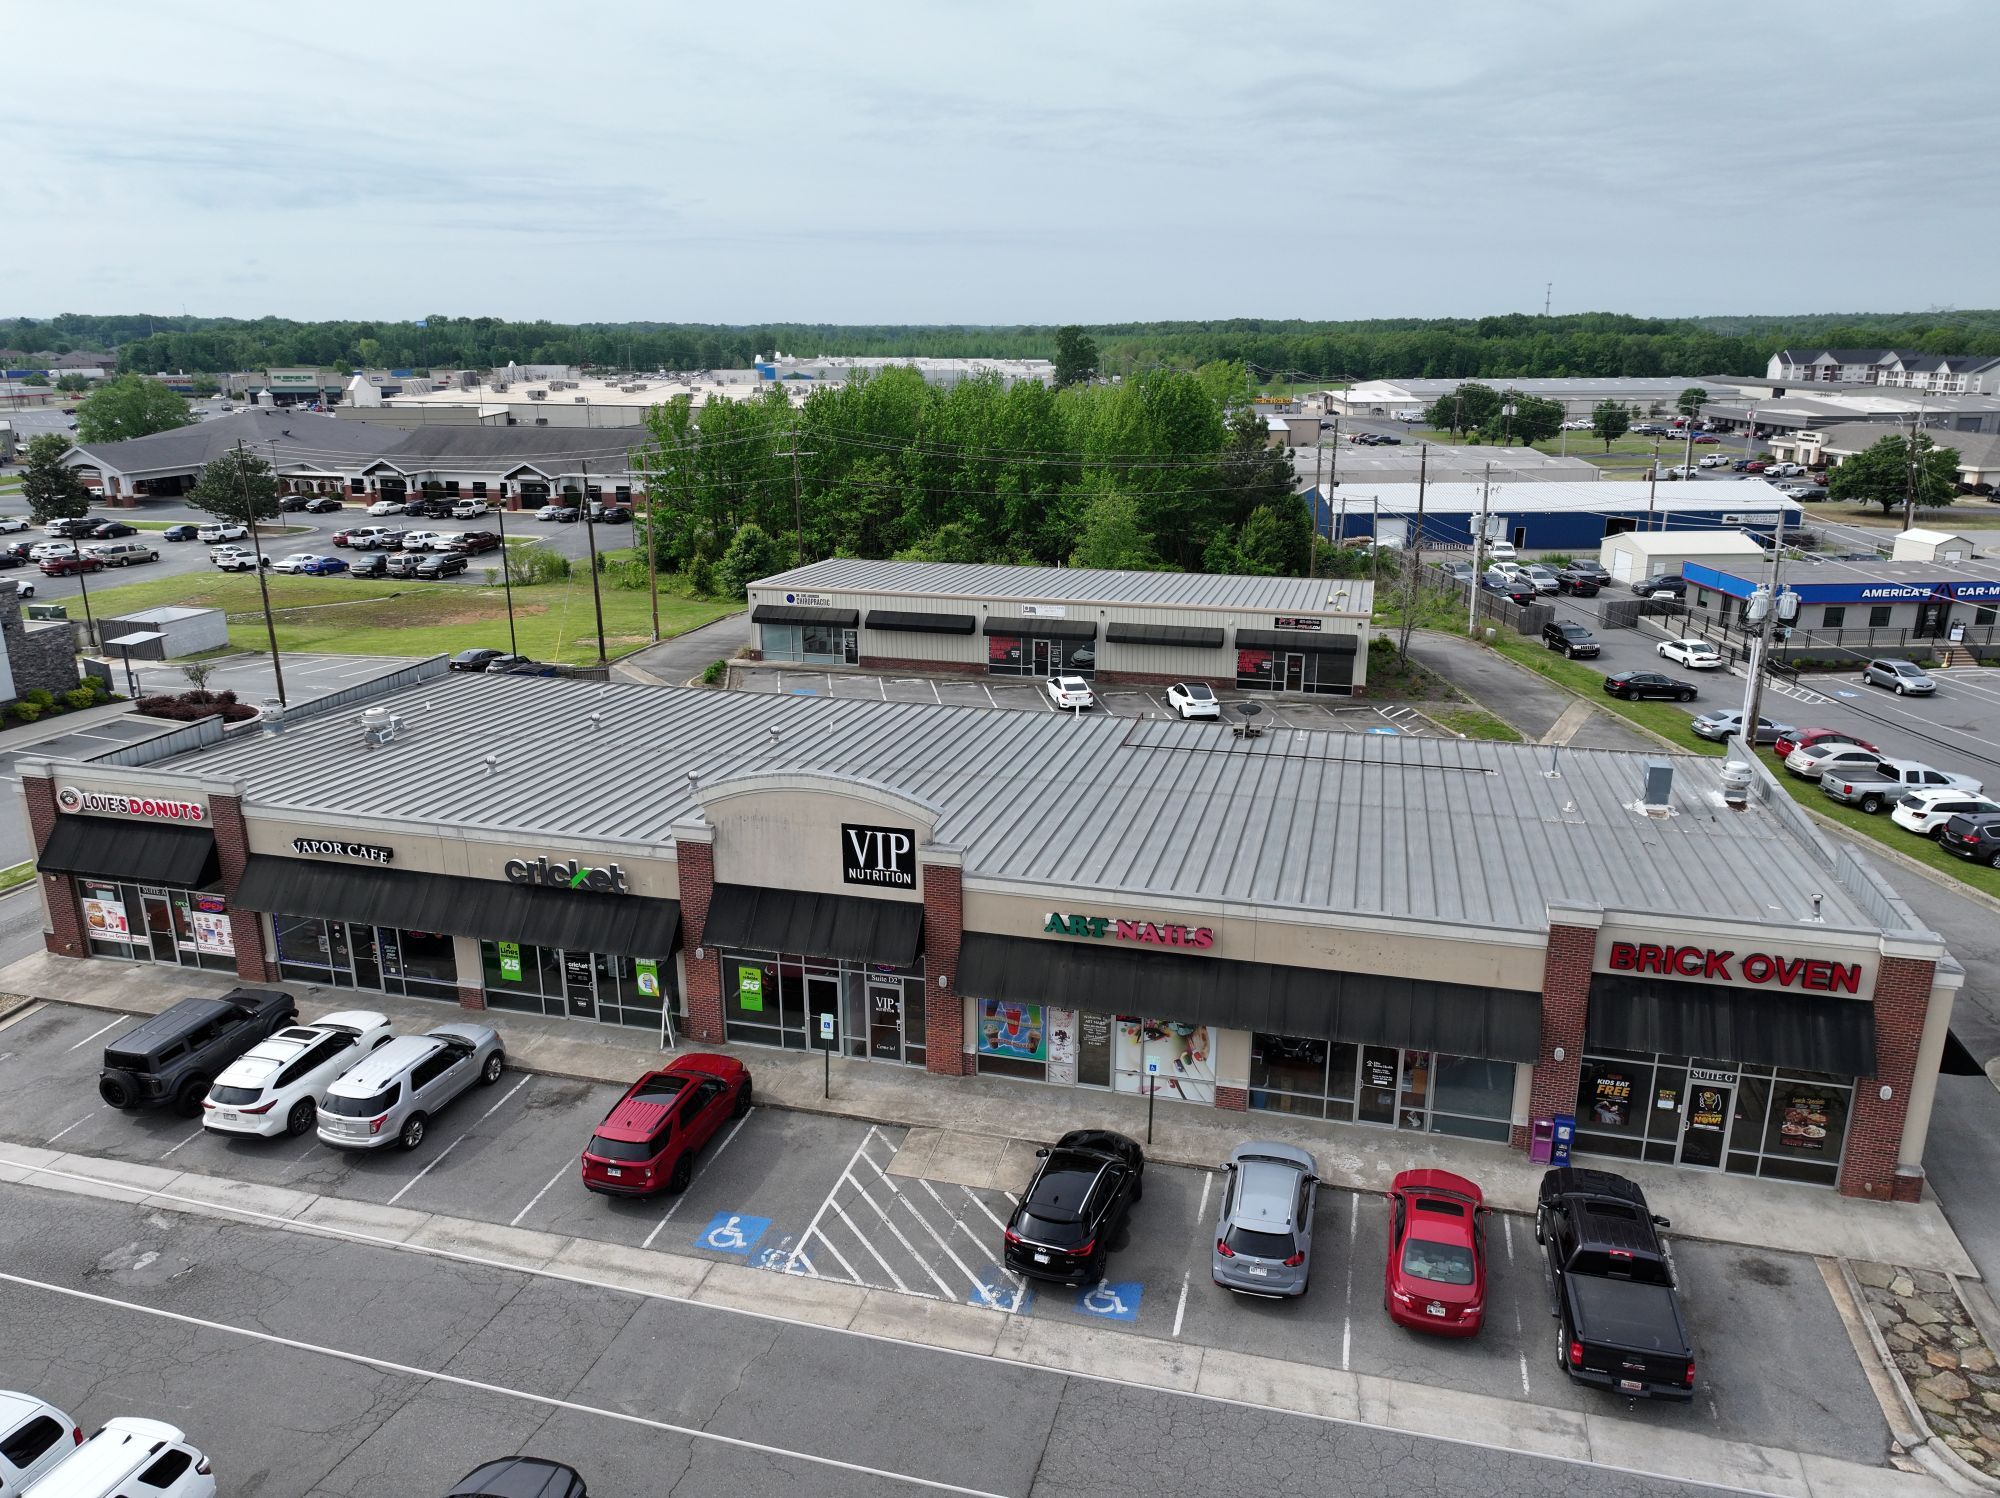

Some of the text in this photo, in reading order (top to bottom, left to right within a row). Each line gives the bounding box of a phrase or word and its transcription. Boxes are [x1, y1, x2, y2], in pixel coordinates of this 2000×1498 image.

[1861, 588, 1932, 598] AMERICA'S
[1957, 586, 2000, 596] CAR-M
[82, 794, 203, 821] LOVE'S DONUTS
[291, 841, 388, 864] VAPOR CAFE
[847, 829, 910, 873] VIP
[504, 855, 629, 895] cricket
[849, 867, 911, 884] NUTRITION
[200, 901, 223, 911] OPEN
[1044, 912, 1214, 949] ART NAILS
[1609, 942, 1862, 994] BRICK OVEN
[742, 980, 760, 990] 5G
[871, 974, 887, 983] Suite
[876, 997, 895, 1009] VIP
[1692, 1069, 1733, 1082] SUITE G
[1596, 1085, 1630, 1097] FREE
